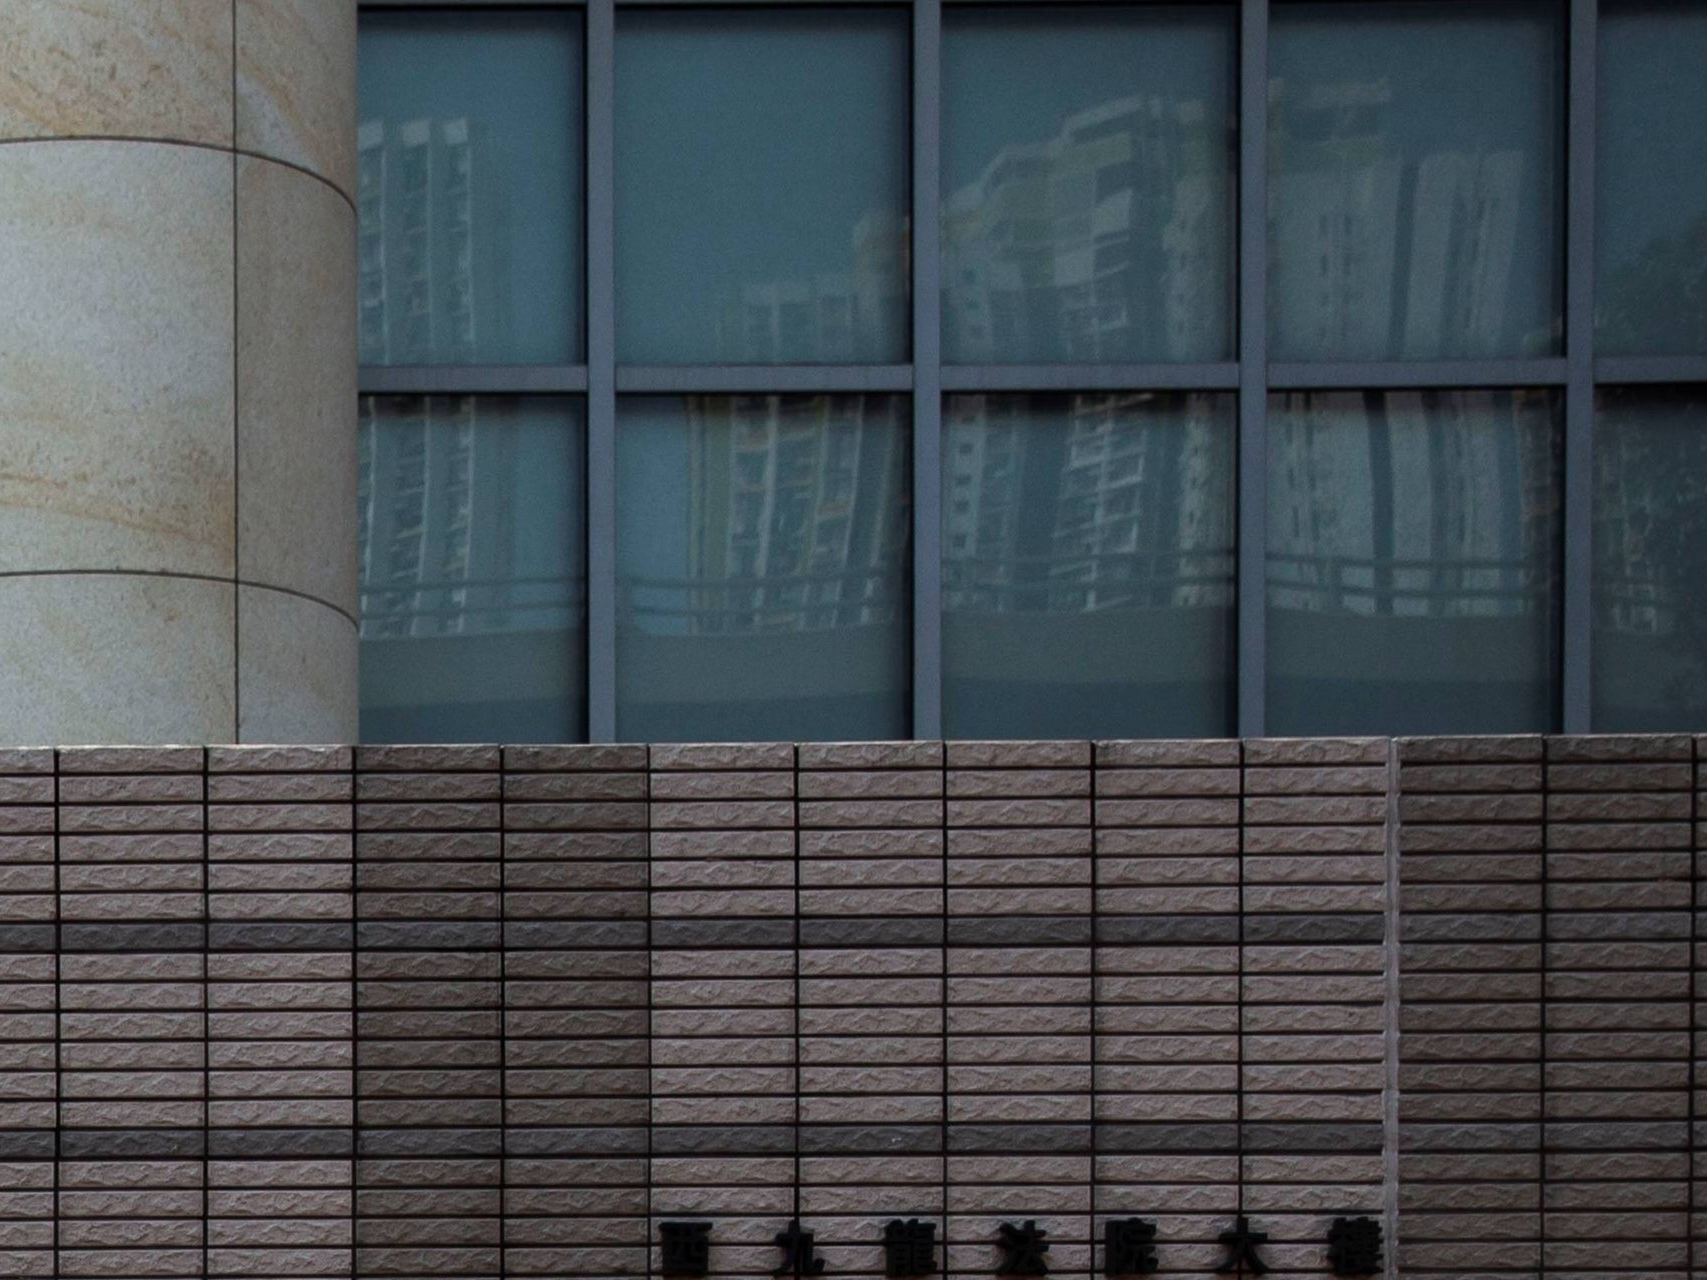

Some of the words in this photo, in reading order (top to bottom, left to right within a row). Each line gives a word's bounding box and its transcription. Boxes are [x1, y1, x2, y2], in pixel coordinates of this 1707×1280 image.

[659, 1217, 1383, 1277] 西九龍法院大樓
